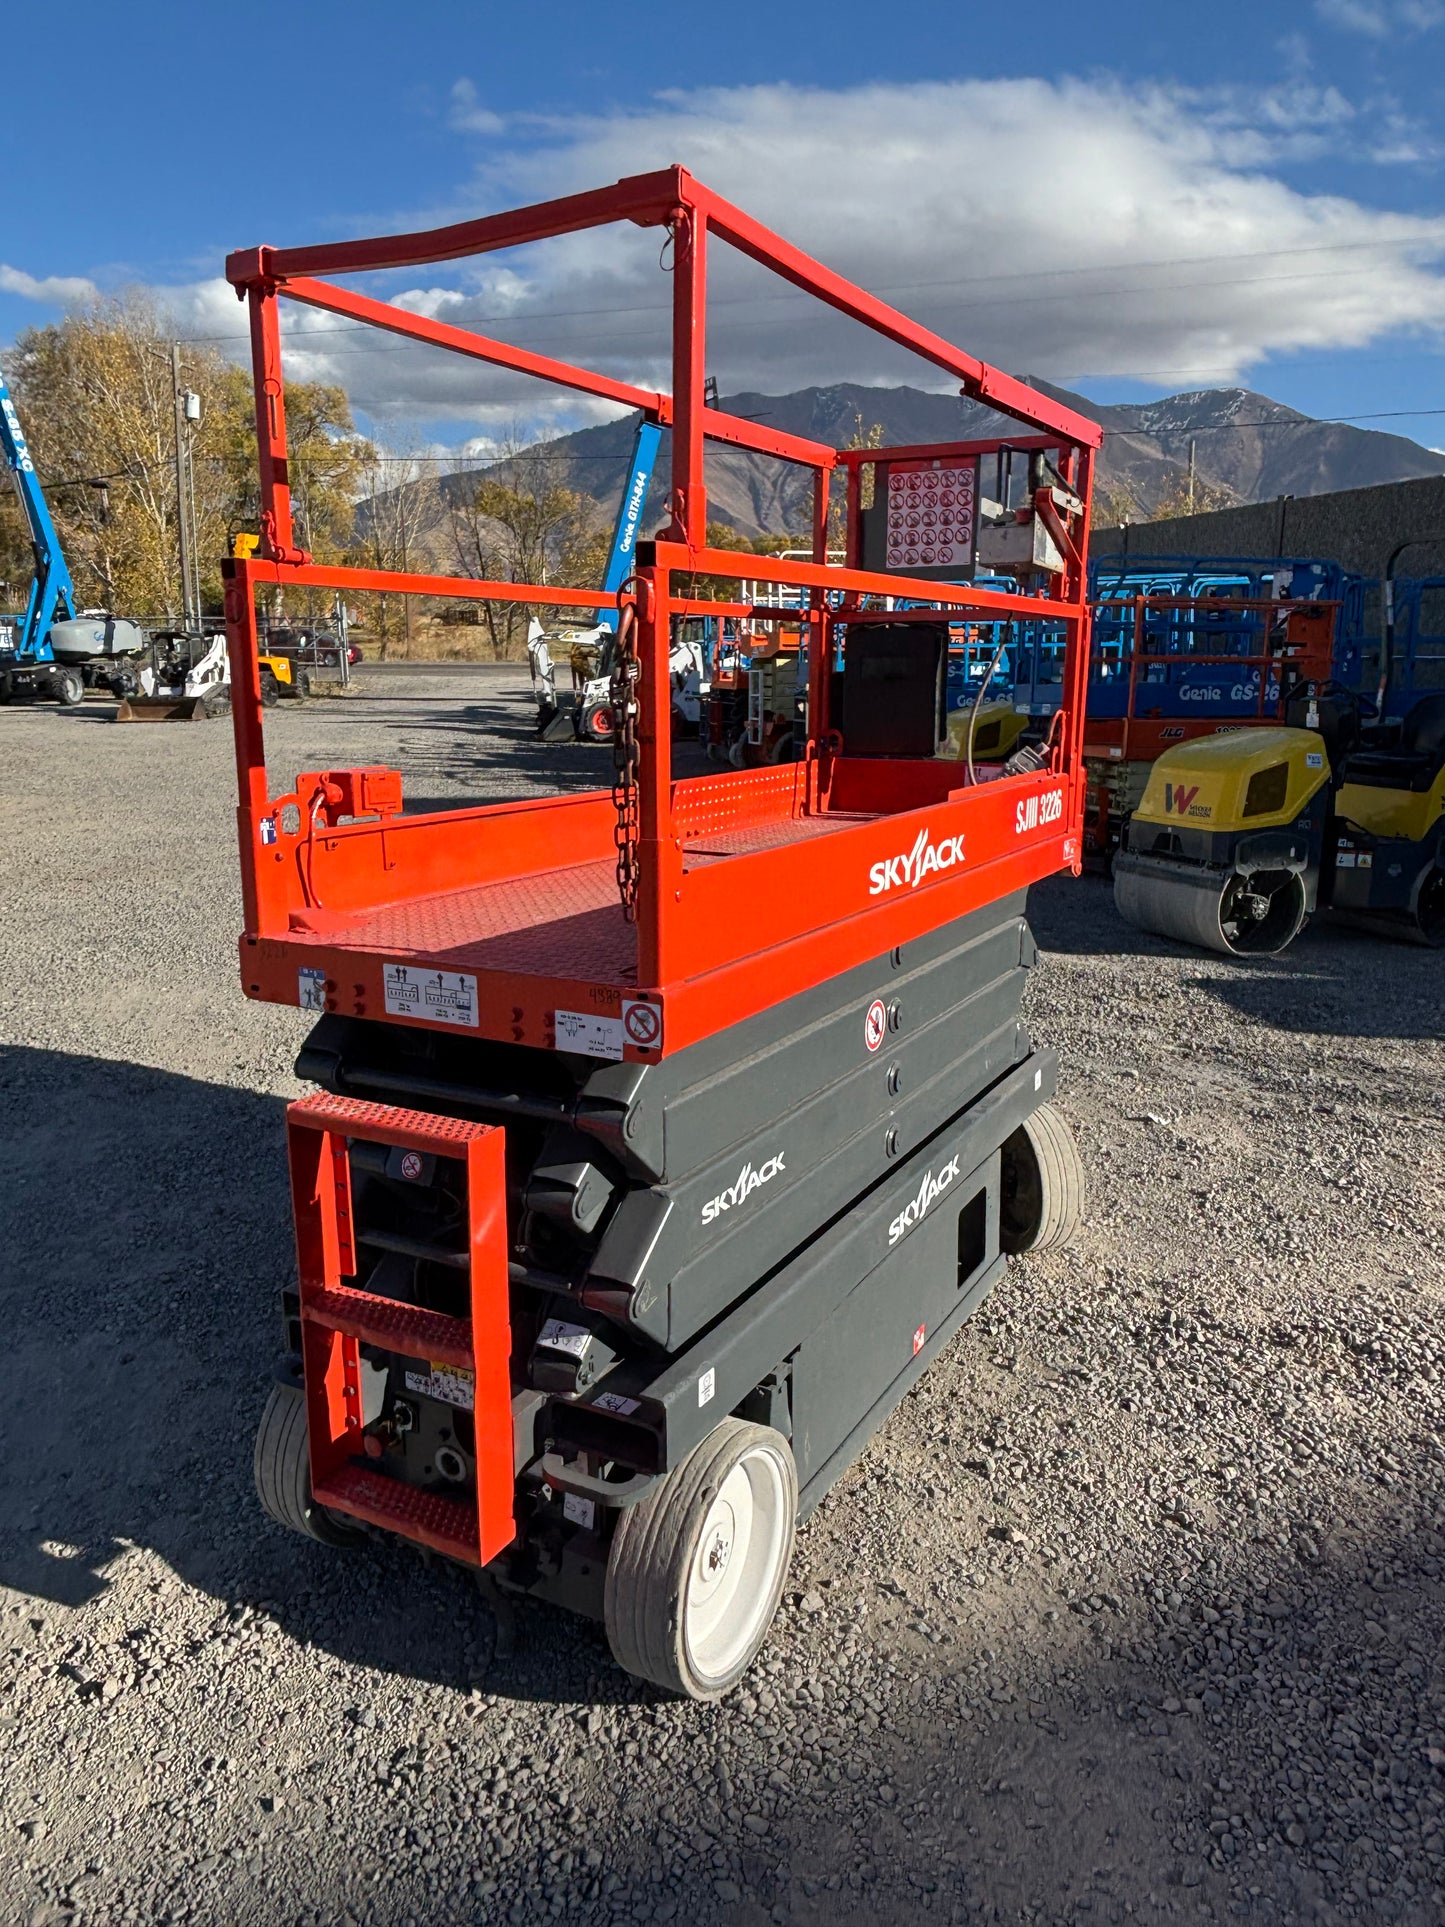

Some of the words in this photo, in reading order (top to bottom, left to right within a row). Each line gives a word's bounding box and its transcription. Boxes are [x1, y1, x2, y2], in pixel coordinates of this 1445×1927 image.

[16, 446, 34, 472] XC
[620, 523, 635, 553] Genie
[628, 471, 647, 521] GTH-844
[1179, 684, 1221, 700] Genie
[1160, 727, 1184, 737] JLG
[1039, 788, 1063, 825] 3226
[869, 828, 966, 895] SKYJACK
[701, 1150, 786, 1226] SKYJACK
[888, 1153, 961, 1246] SKYJACK
